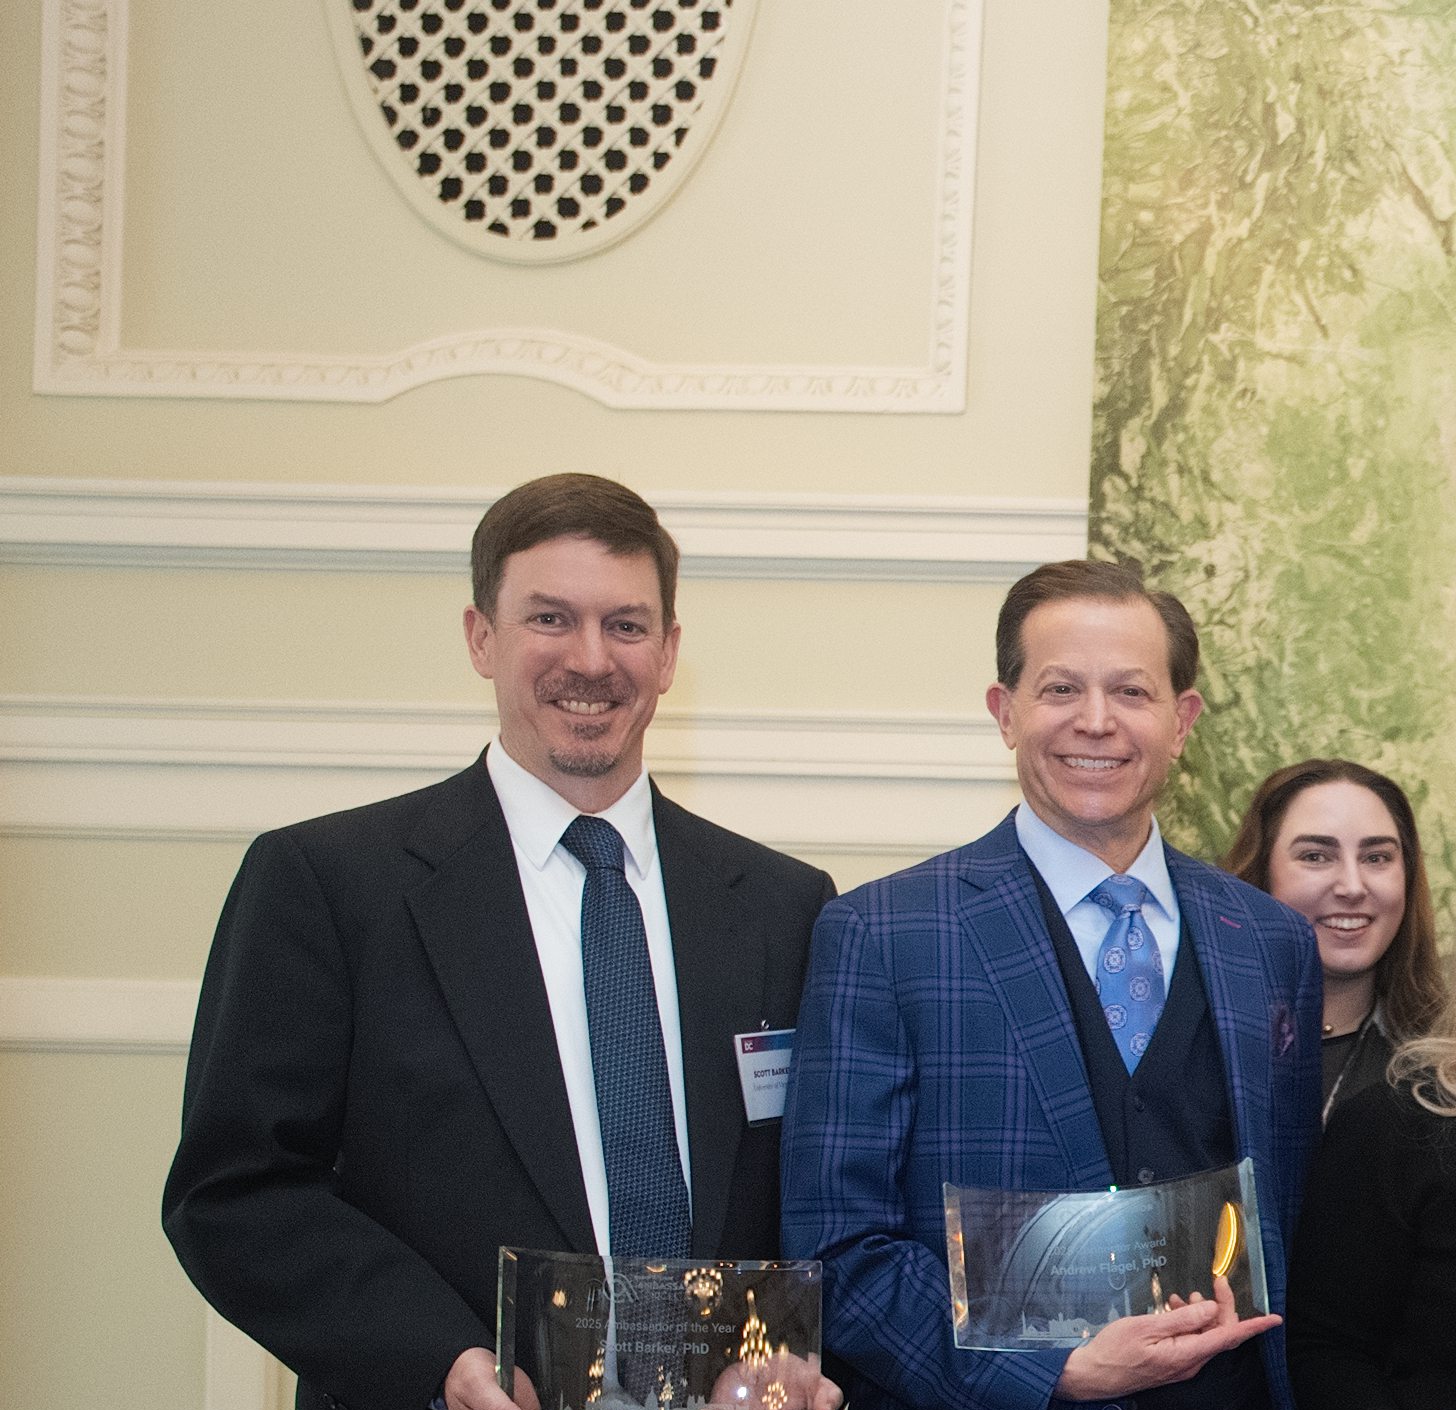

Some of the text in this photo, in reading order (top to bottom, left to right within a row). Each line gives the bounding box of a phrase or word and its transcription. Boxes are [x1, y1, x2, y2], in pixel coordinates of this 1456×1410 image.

[753, 1067, 790, 1079] SCOTT BARKE
[1134, 1237, 1167, 1250] Award
[1050, 1264, 1097, 1276] Andrew
[1142, 1255, 1168, 1269] PhD
[575, 1318, 602, 1330] 2025
[676, 1321, 689, 1333] of
[690, 1322, 709, 1333] the
[711, 1323, 737, 1334] Year
[599, 1339, 632, 1352] Sott
[683, 1342, 711, 1355] PhD
